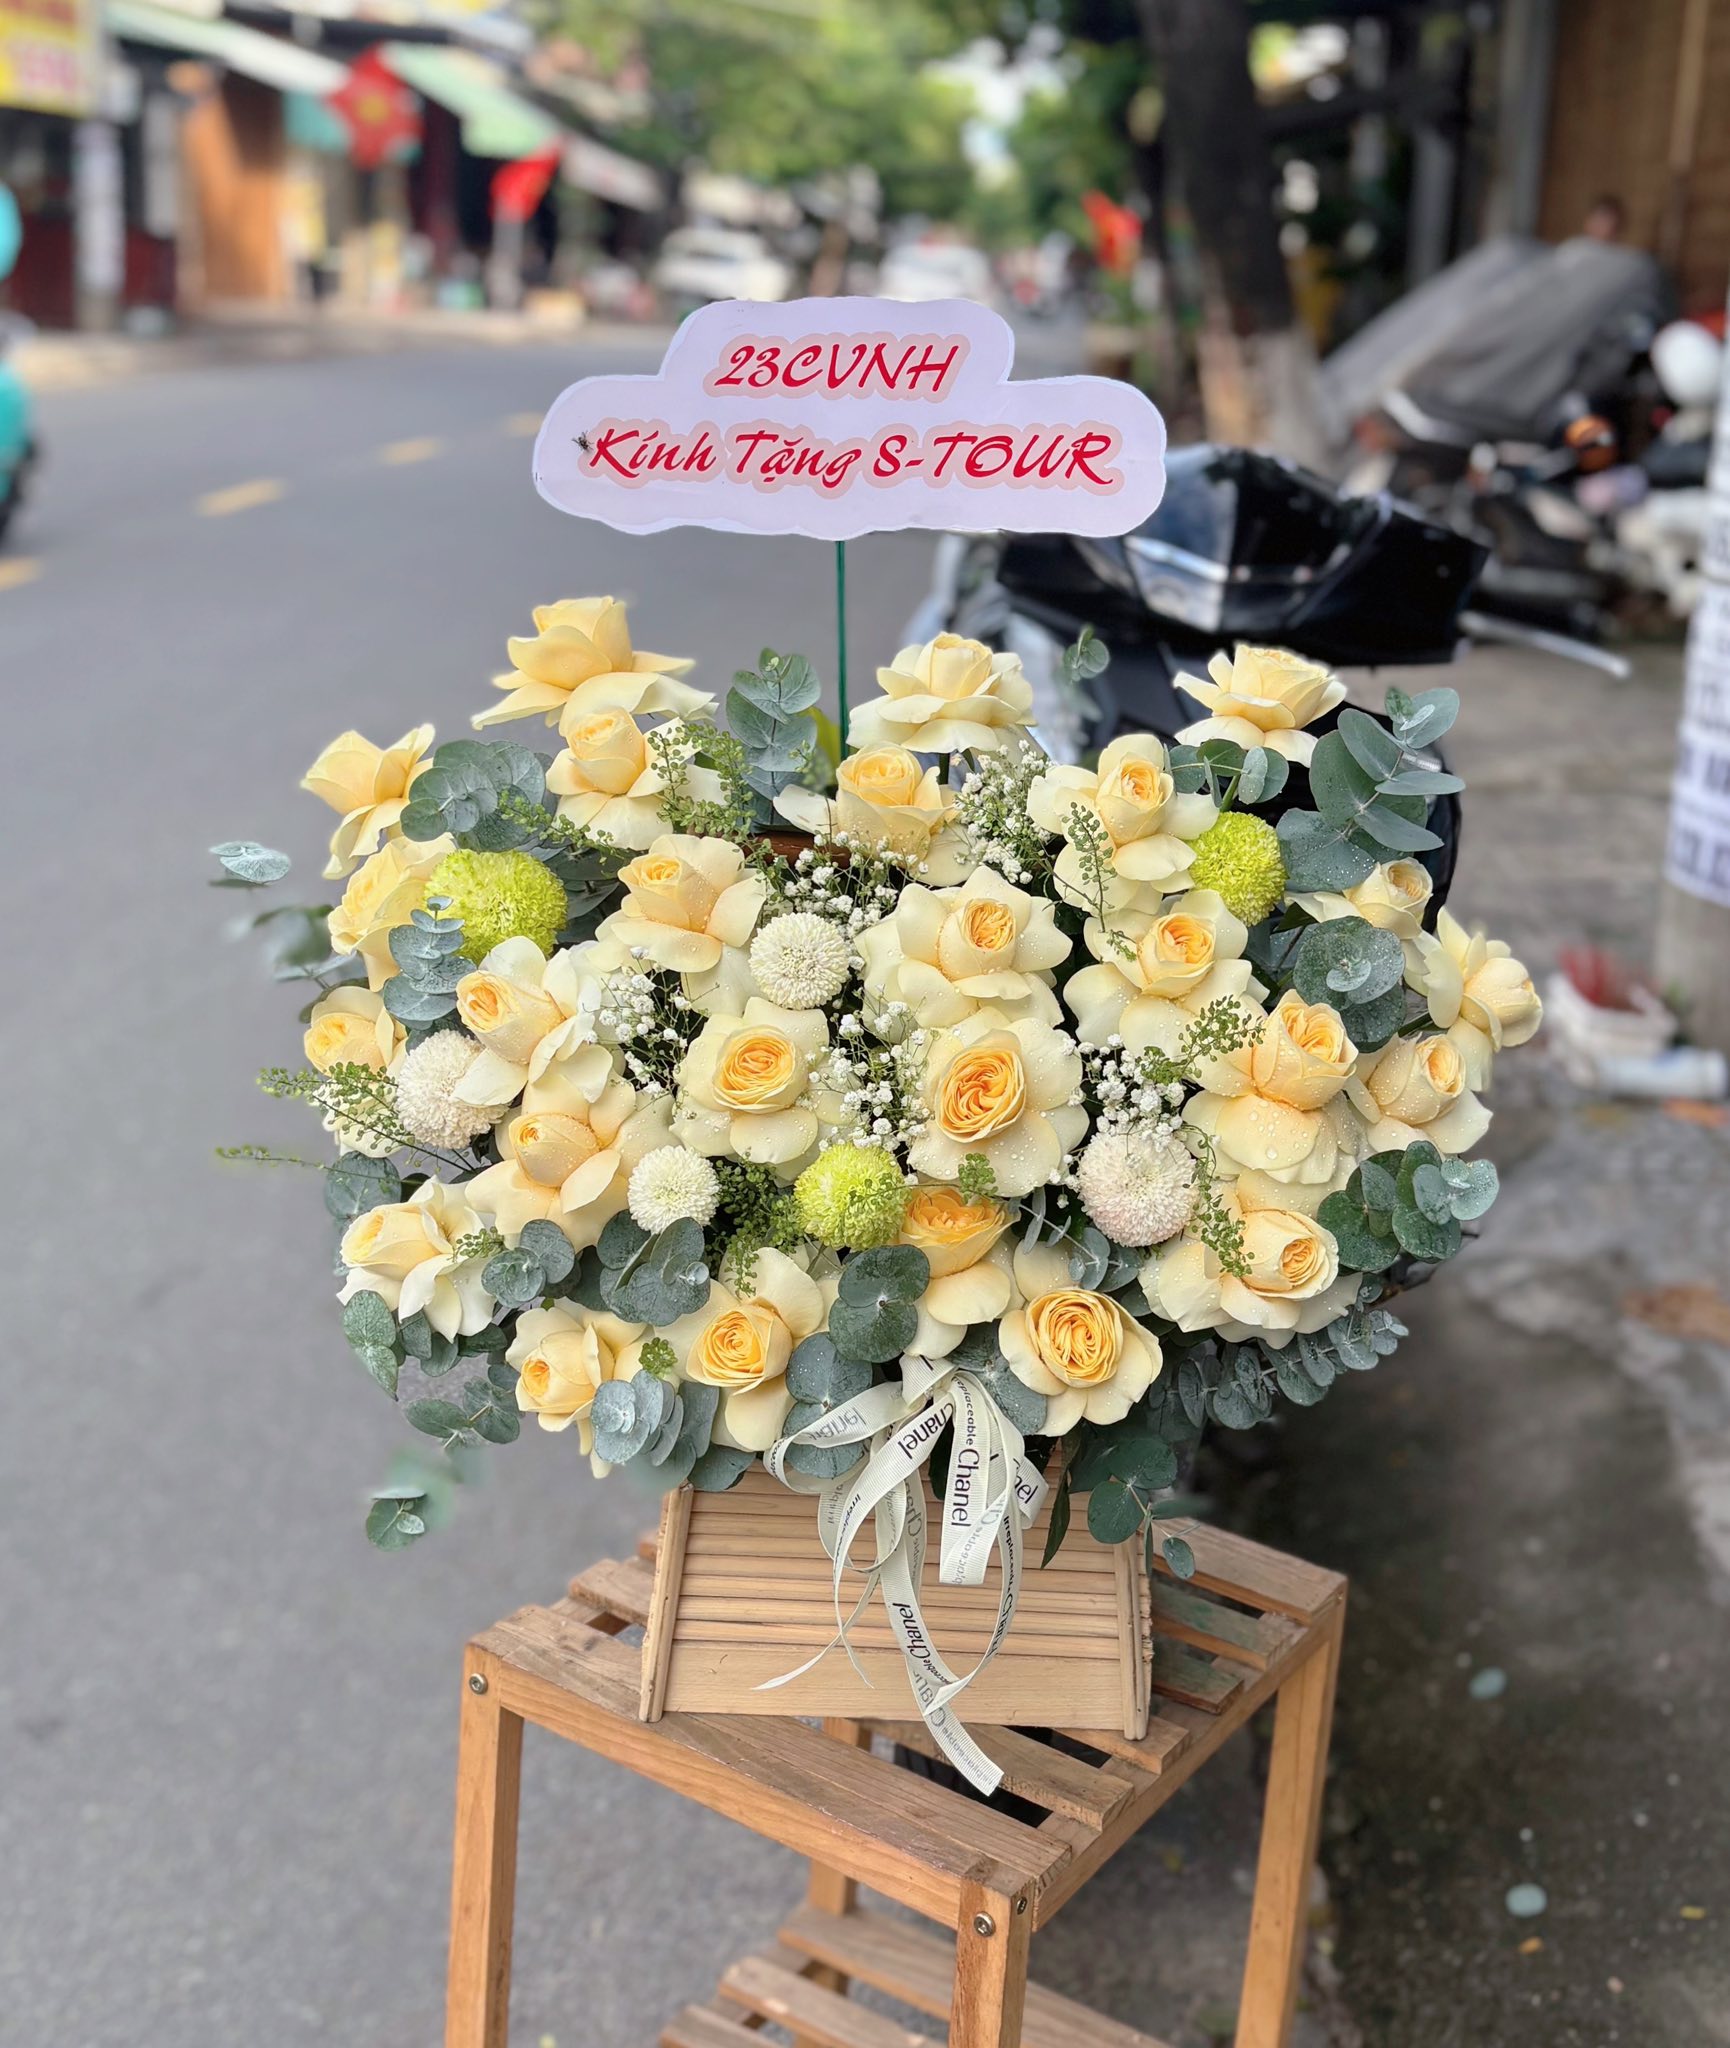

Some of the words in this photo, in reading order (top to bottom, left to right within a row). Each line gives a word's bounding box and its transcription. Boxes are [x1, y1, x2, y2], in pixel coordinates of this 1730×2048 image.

[714, 343, 959, 392] 23CVNH
[591, 428, 718, 478] Kính
[735, 430, 862, 488] Tặng
[873, 432, 1113, 485] S-TOUR
[951, 1449, 980, 1527] Chanel
[892, 1602, 931, 1659] Chanel
